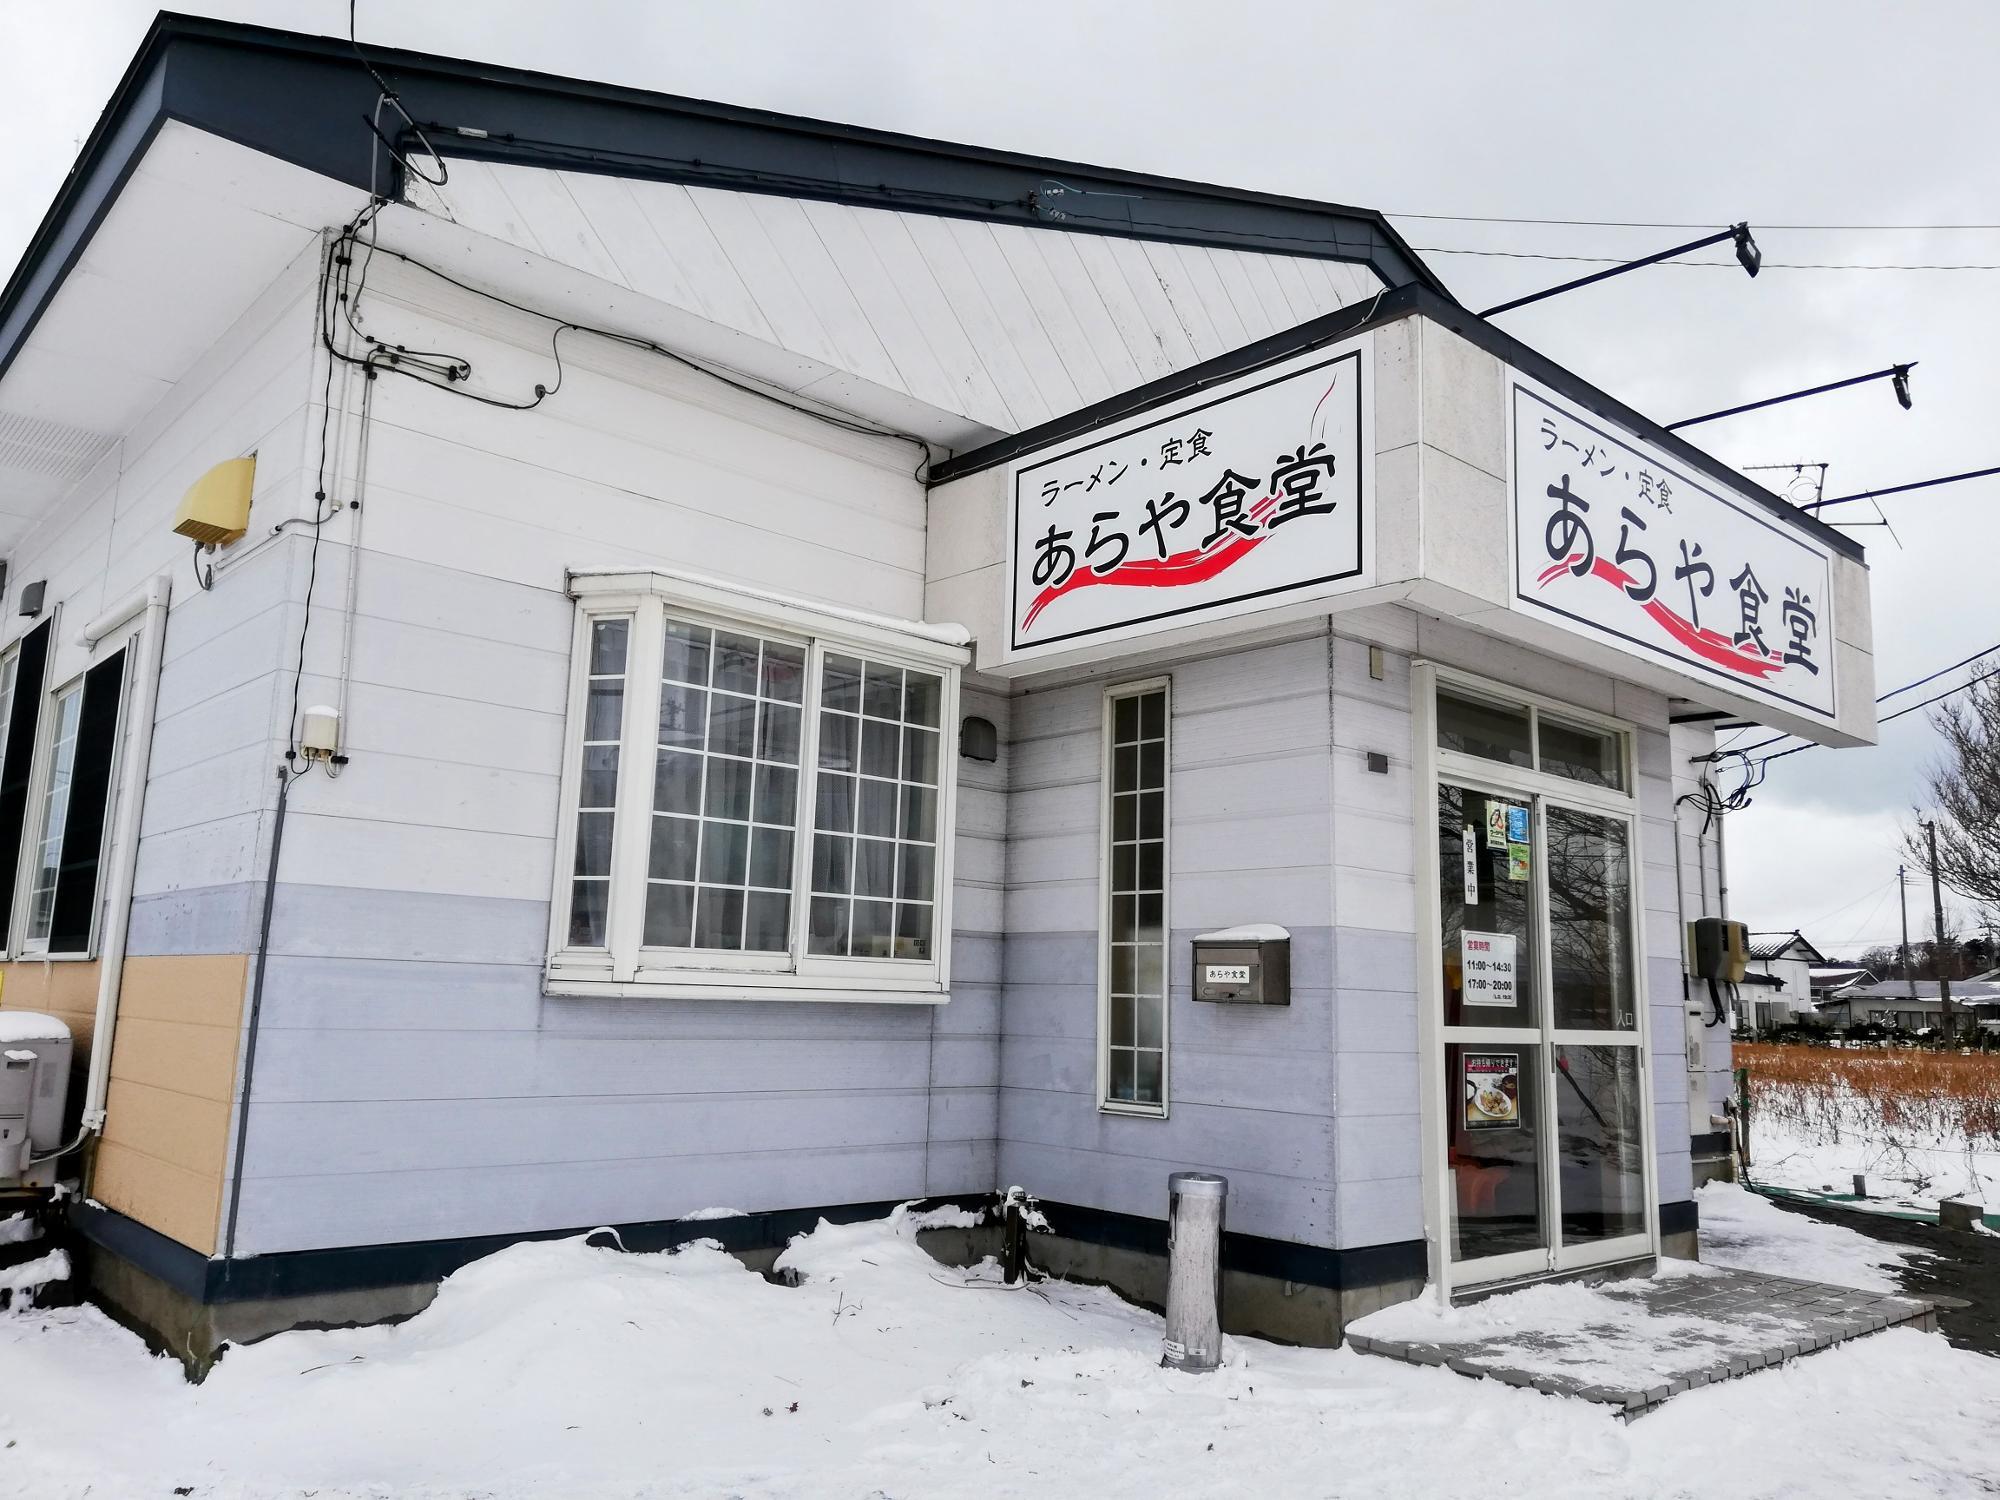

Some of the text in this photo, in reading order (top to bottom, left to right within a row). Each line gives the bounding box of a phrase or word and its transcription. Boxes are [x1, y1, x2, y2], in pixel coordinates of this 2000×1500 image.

[1041, 428, 1213, 507] ラーメン・定食
[1541, 418, 1673, 514] ラーメン・定食
[1031, 442, 1337, 586] あらや食堂
[1545, 473, 1819, 676] あらや食堂
[1465, 838, 1476, 898] 営業中
[1209, 970, 1246, 979] あらや食堂
[1616, 1009, 1633, 1027] 入口
